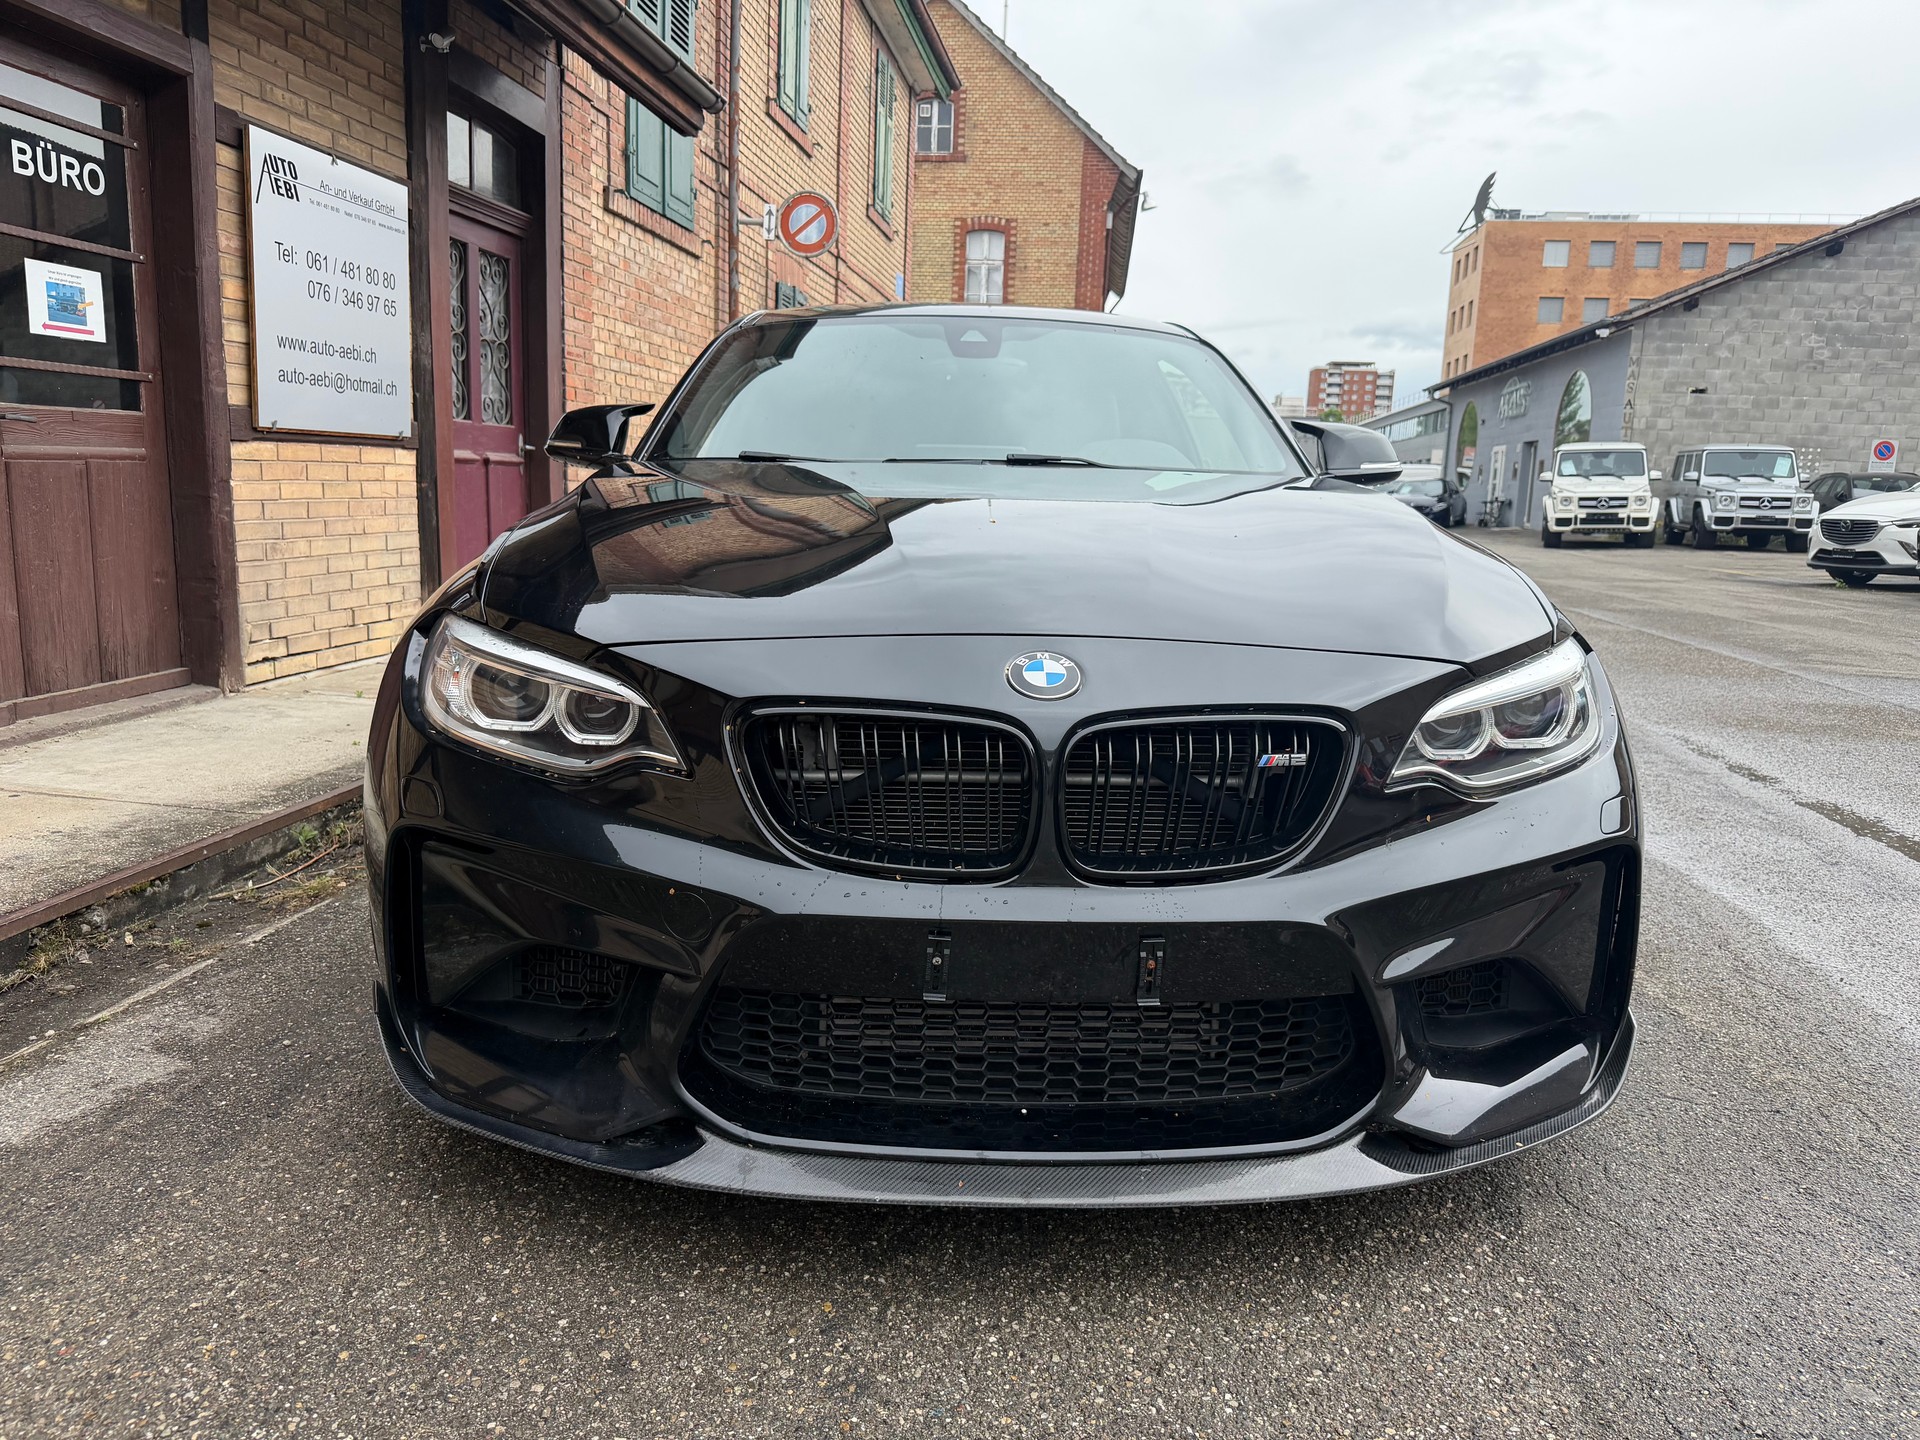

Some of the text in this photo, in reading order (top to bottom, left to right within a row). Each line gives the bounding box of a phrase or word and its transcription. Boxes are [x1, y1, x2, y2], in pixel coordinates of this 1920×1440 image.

[11, 139, 105, 196] BÜRO
[256, 152, 298, 188] AUTO
[320, 180, 395, 215] An- und Verkauf GmbH
[274, 241, 396, 290] Tel: 061 / 481 80 80
[308, 280, 397, 317] 076 / 346 97 65
[277, 335, 377, 364] www.auto-aebi.ch
[278, 368, 398, 397] auto-aebi@hotmail.ch
[1016, 653, 1073, 667] BMW
[1268, 754, 1306, 766] M2
